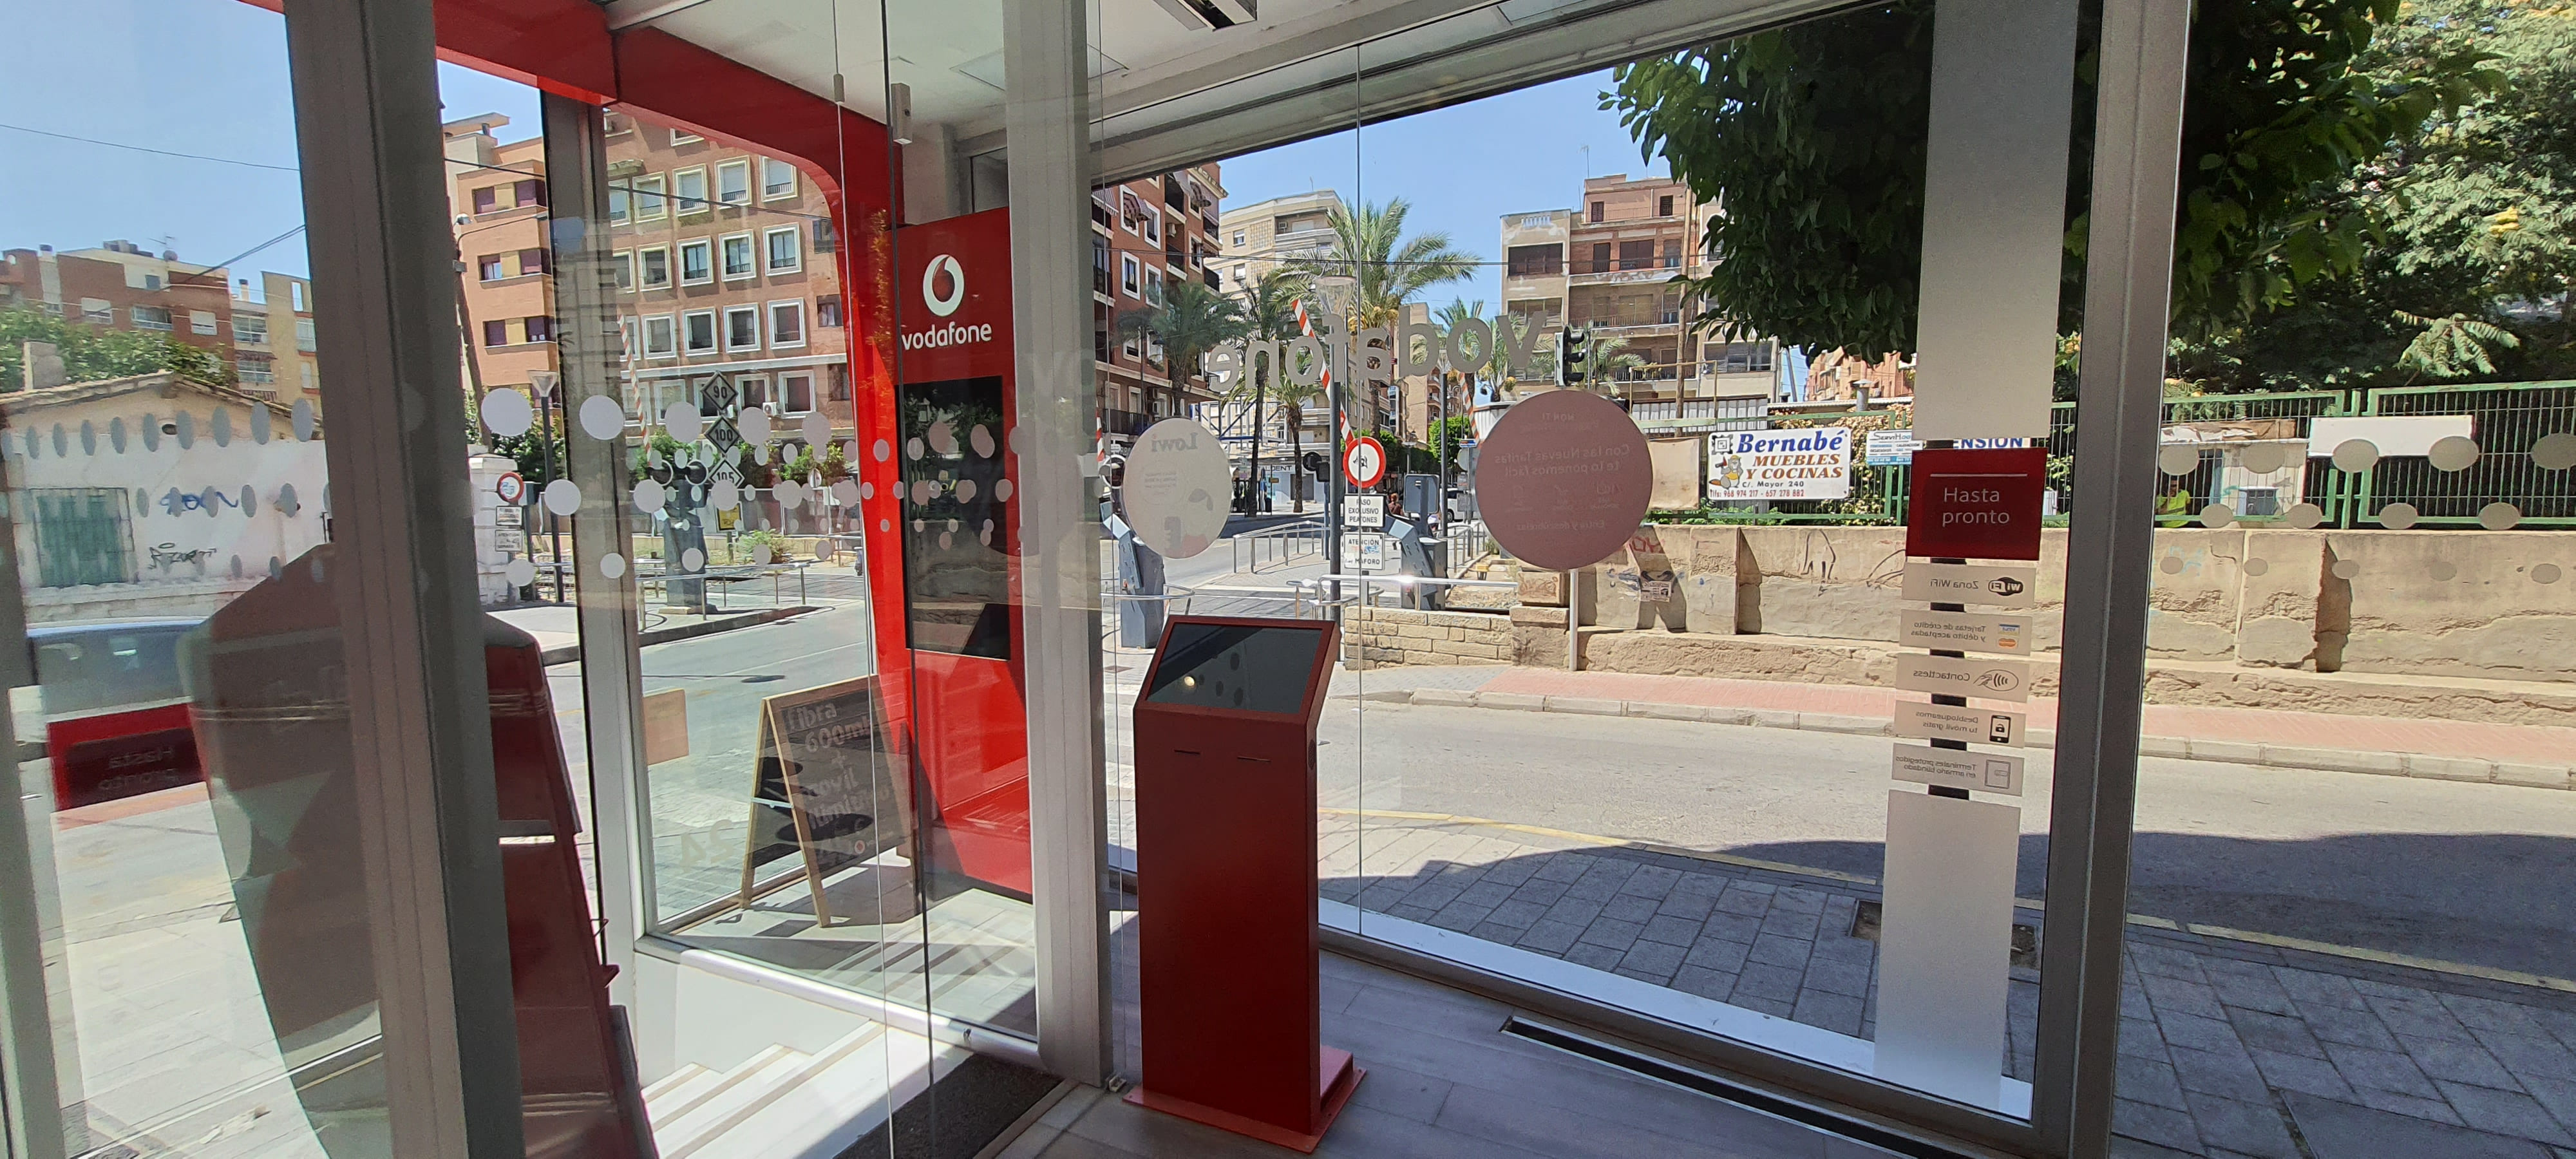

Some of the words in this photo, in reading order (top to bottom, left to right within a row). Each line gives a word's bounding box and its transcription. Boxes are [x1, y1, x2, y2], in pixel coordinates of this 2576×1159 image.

[901, 321, 992, 351] vodafone
[714, 386, 728, 399] 90
[715, 429, 734, 442] 100
[1736, 429, 1844, 453] Bernabé
[1752, 453, 1841, 467] MUEBLES
[716, 471, 735, 483] 105
[1746, 469, 1757, 480] Y
[1761, 467, 1843, 479] COCINAS
[1944, 487, 2000, 503] Hasta
[1942, 509, 2010, 527] pronto
